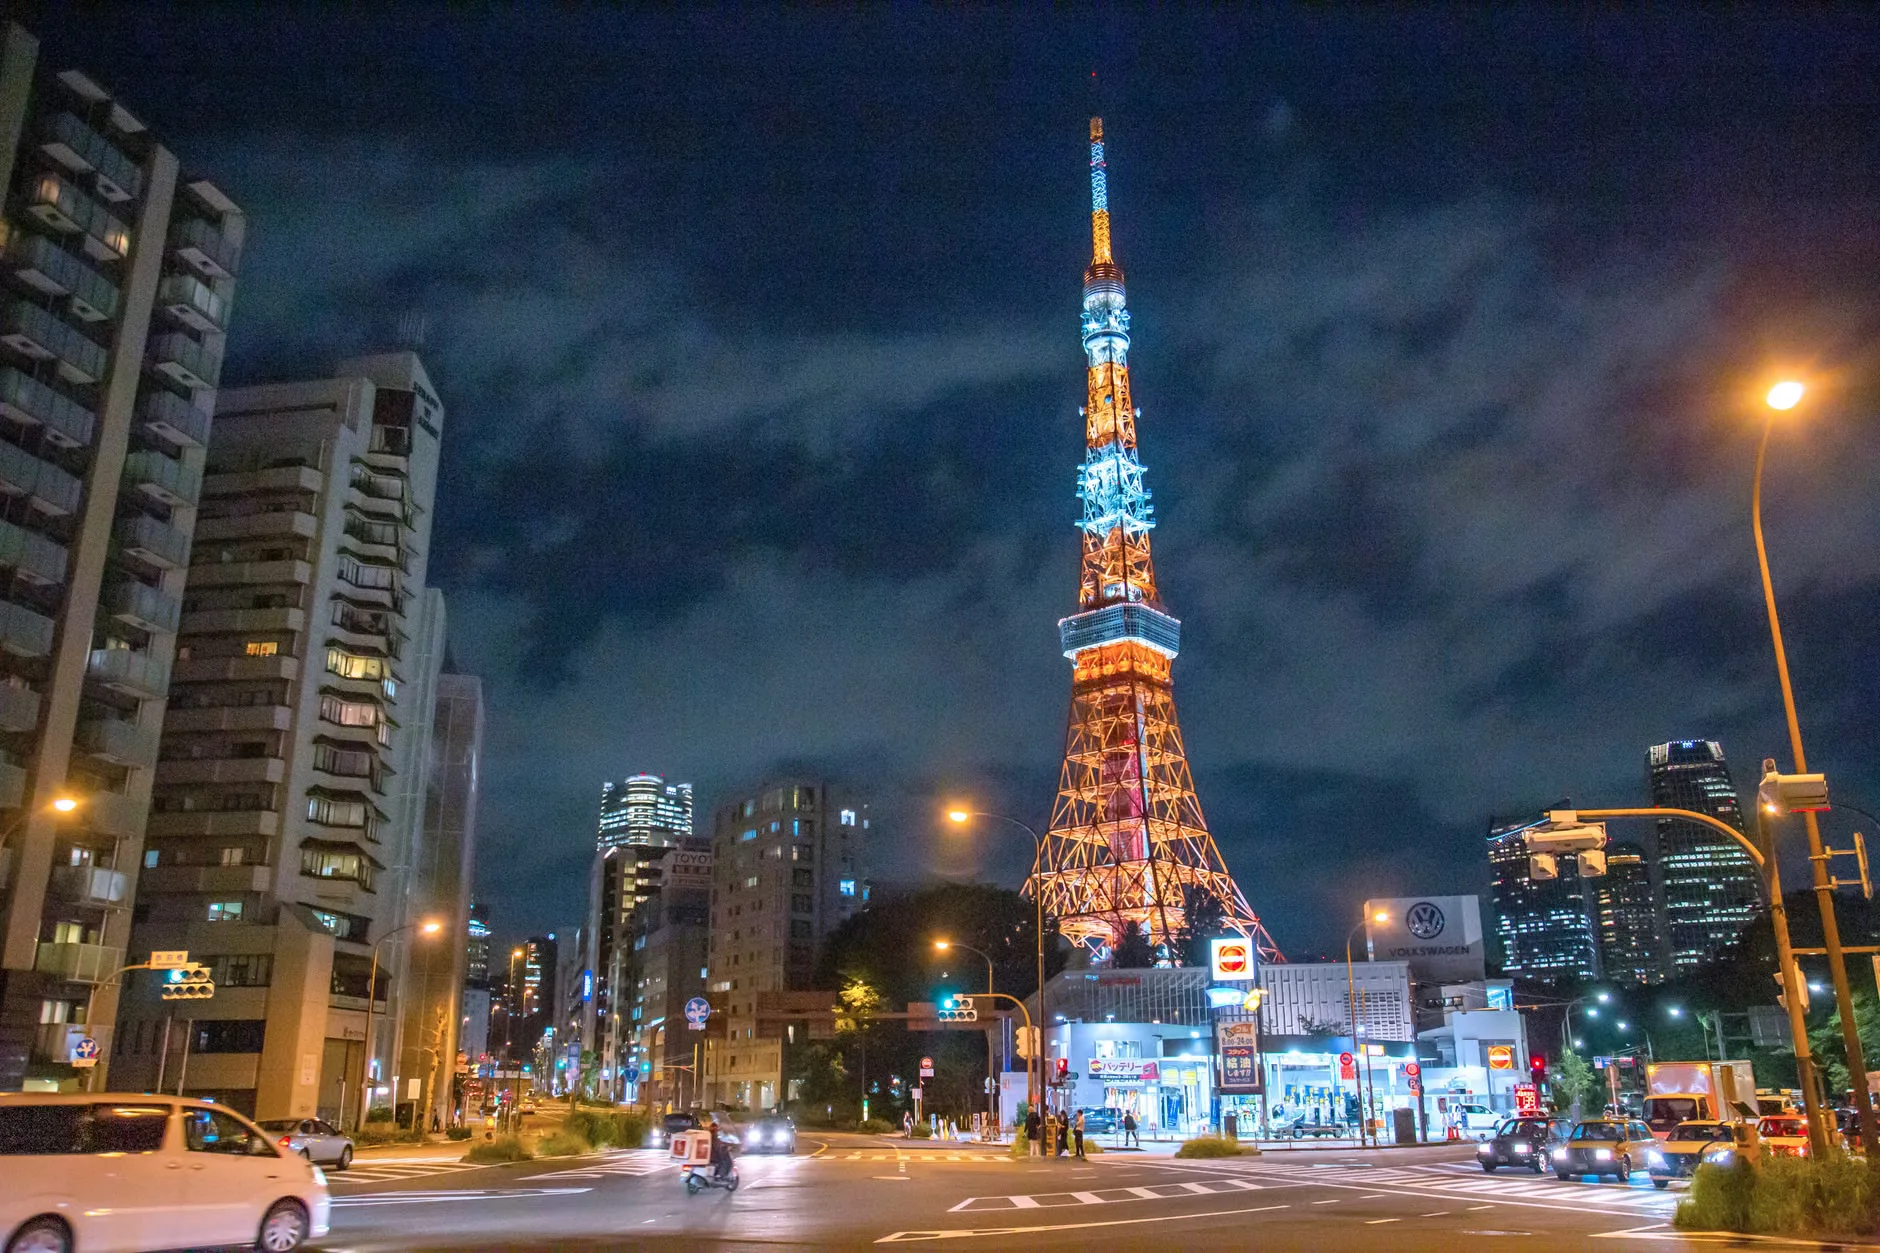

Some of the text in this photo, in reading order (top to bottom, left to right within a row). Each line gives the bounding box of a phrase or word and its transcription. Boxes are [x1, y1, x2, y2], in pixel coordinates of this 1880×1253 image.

[673, 853, 713, 864] TOYOT
[1389, 946, 1470, 957] VOLKSWAGEN
[1103, 1062, 1142, 1072] バッテリー
[1226, 1057, 1251, 1069] 給油
